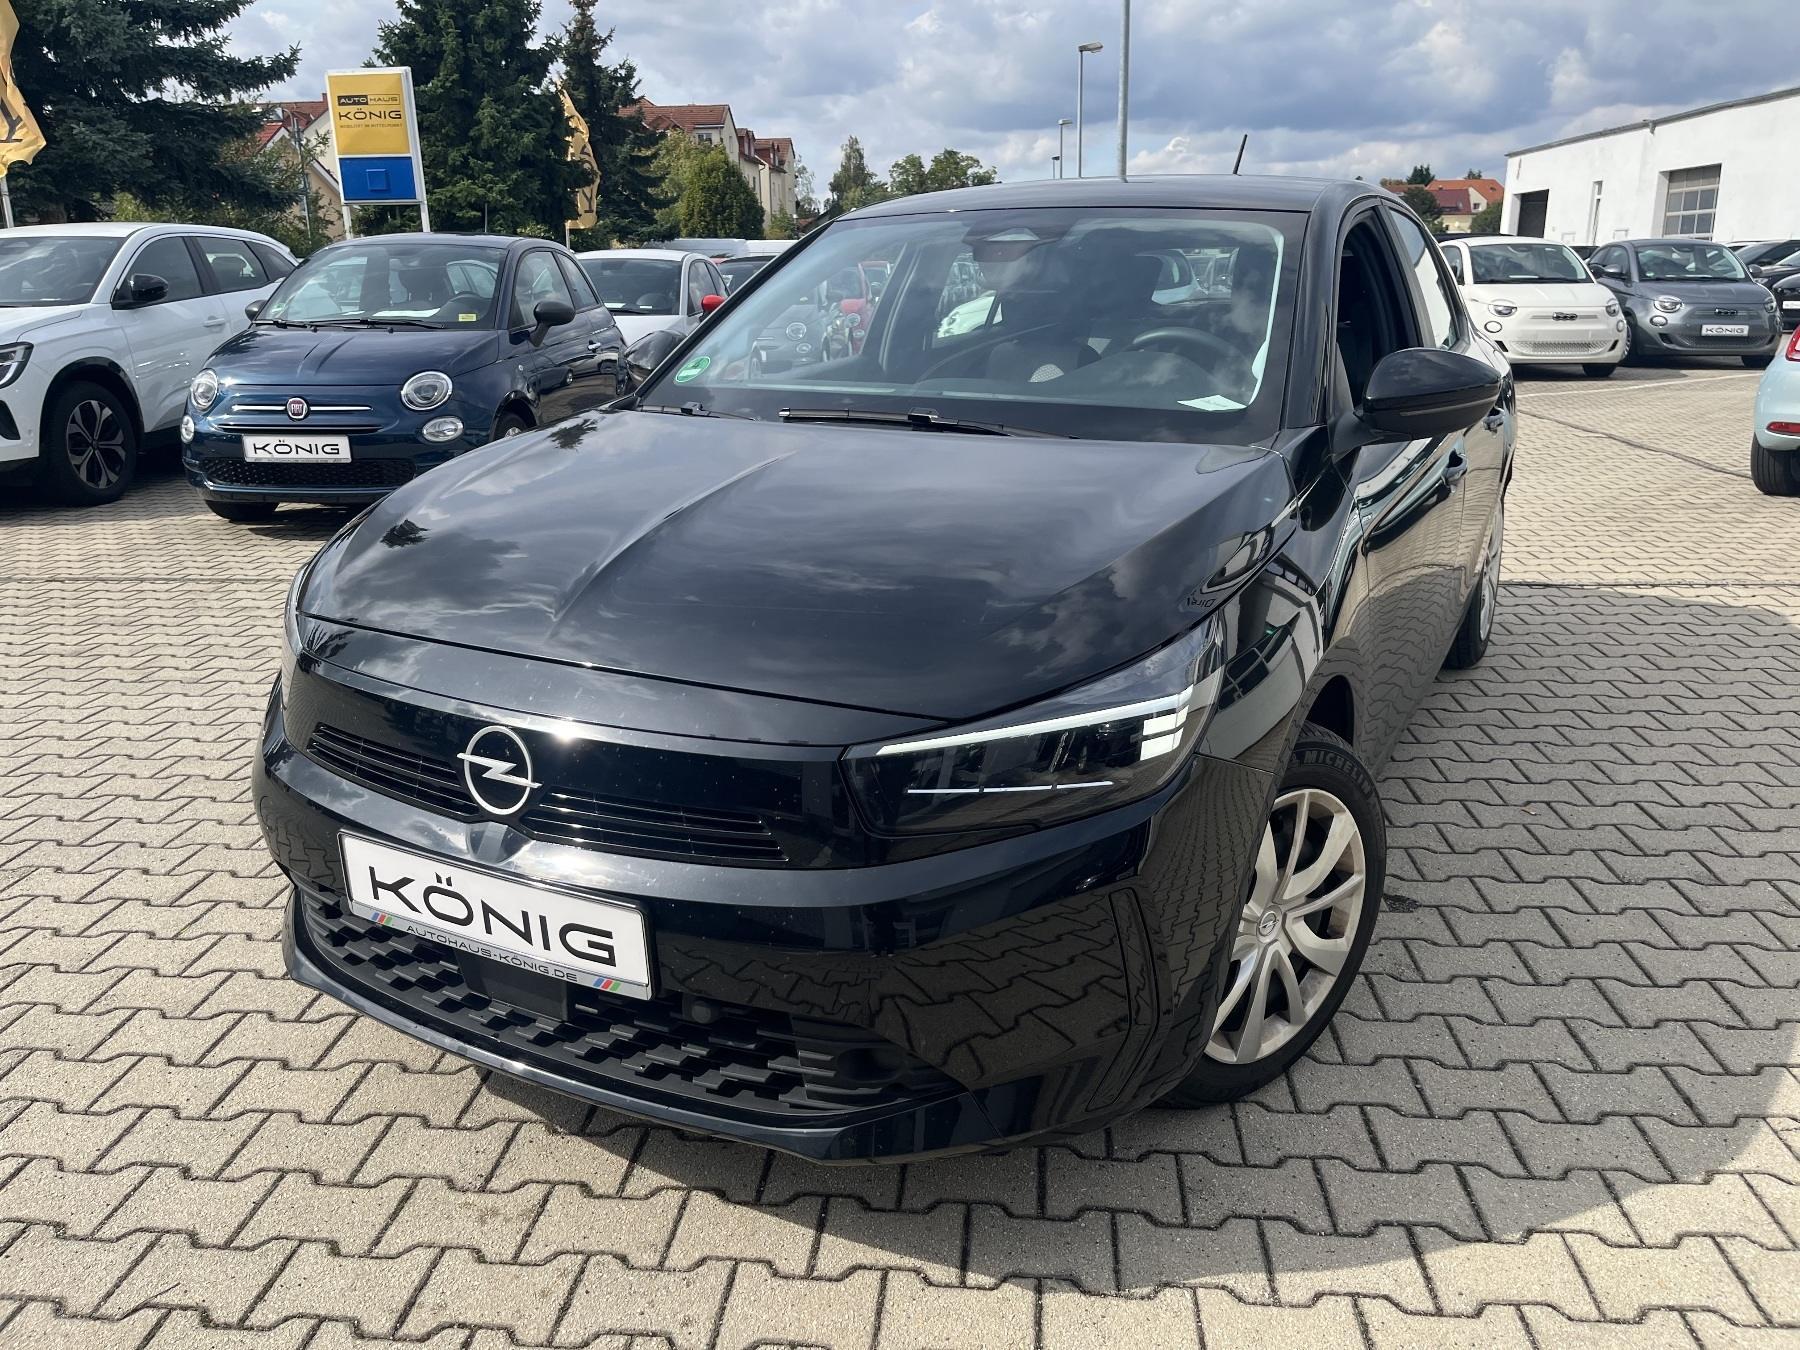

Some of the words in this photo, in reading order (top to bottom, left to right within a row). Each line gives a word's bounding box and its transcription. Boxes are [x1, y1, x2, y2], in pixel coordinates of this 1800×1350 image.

[338, 107, 402, 121] KÖNIG
[1705, 326, 1745, 334] KÖNIG
[253, 439, 340, 455] KÖNIG
[1303, 750, 1372, 797] MICHELIN
[368, 865, 617, 968] KÖNIG
[406, 924, 578, 983] AUTOHAUS-KÖNIG.DE
